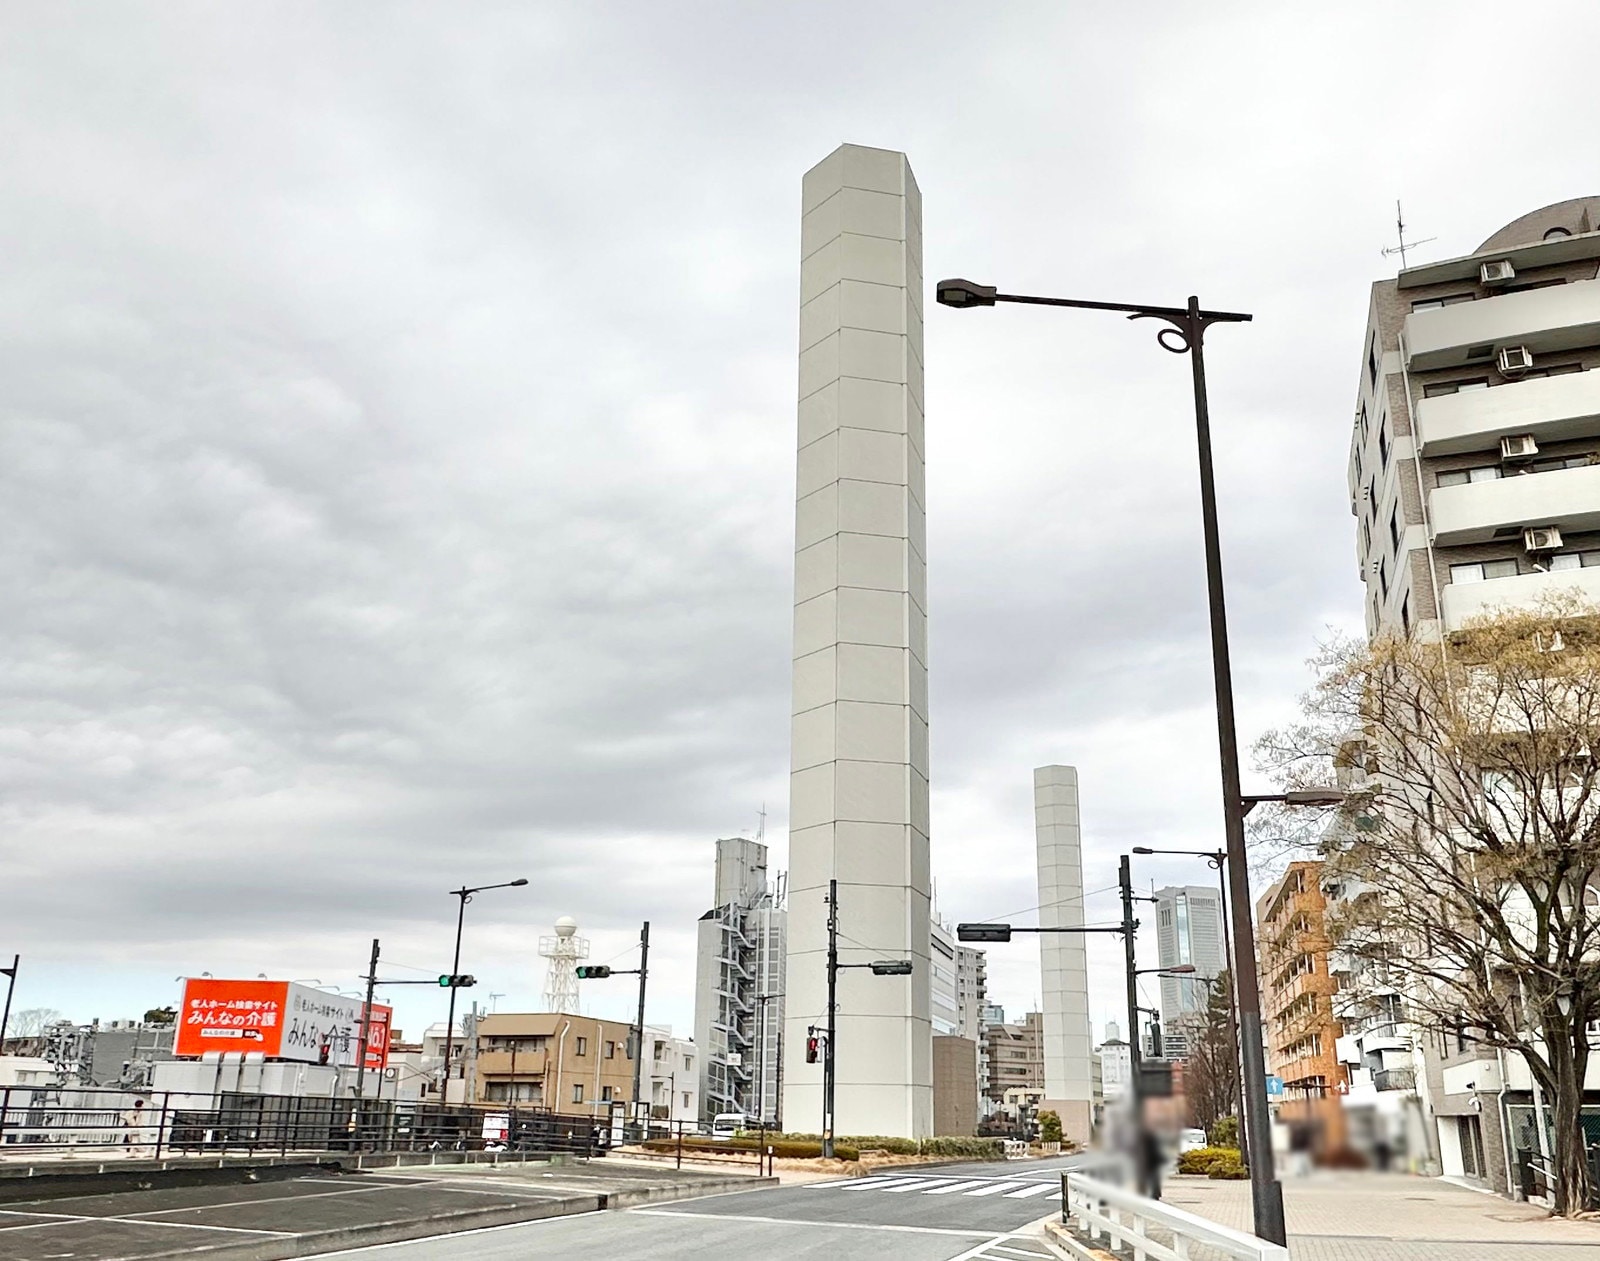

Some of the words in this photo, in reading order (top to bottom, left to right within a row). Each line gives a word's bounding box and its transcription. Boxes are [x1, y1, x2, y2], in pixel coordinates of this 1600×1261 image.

[190, 999, 278, 1010] 老人ホーム検索サイト
[187, 1010, 277, 1026] みんなの介護
[287, 1017, 352, 1053] みんな介護
